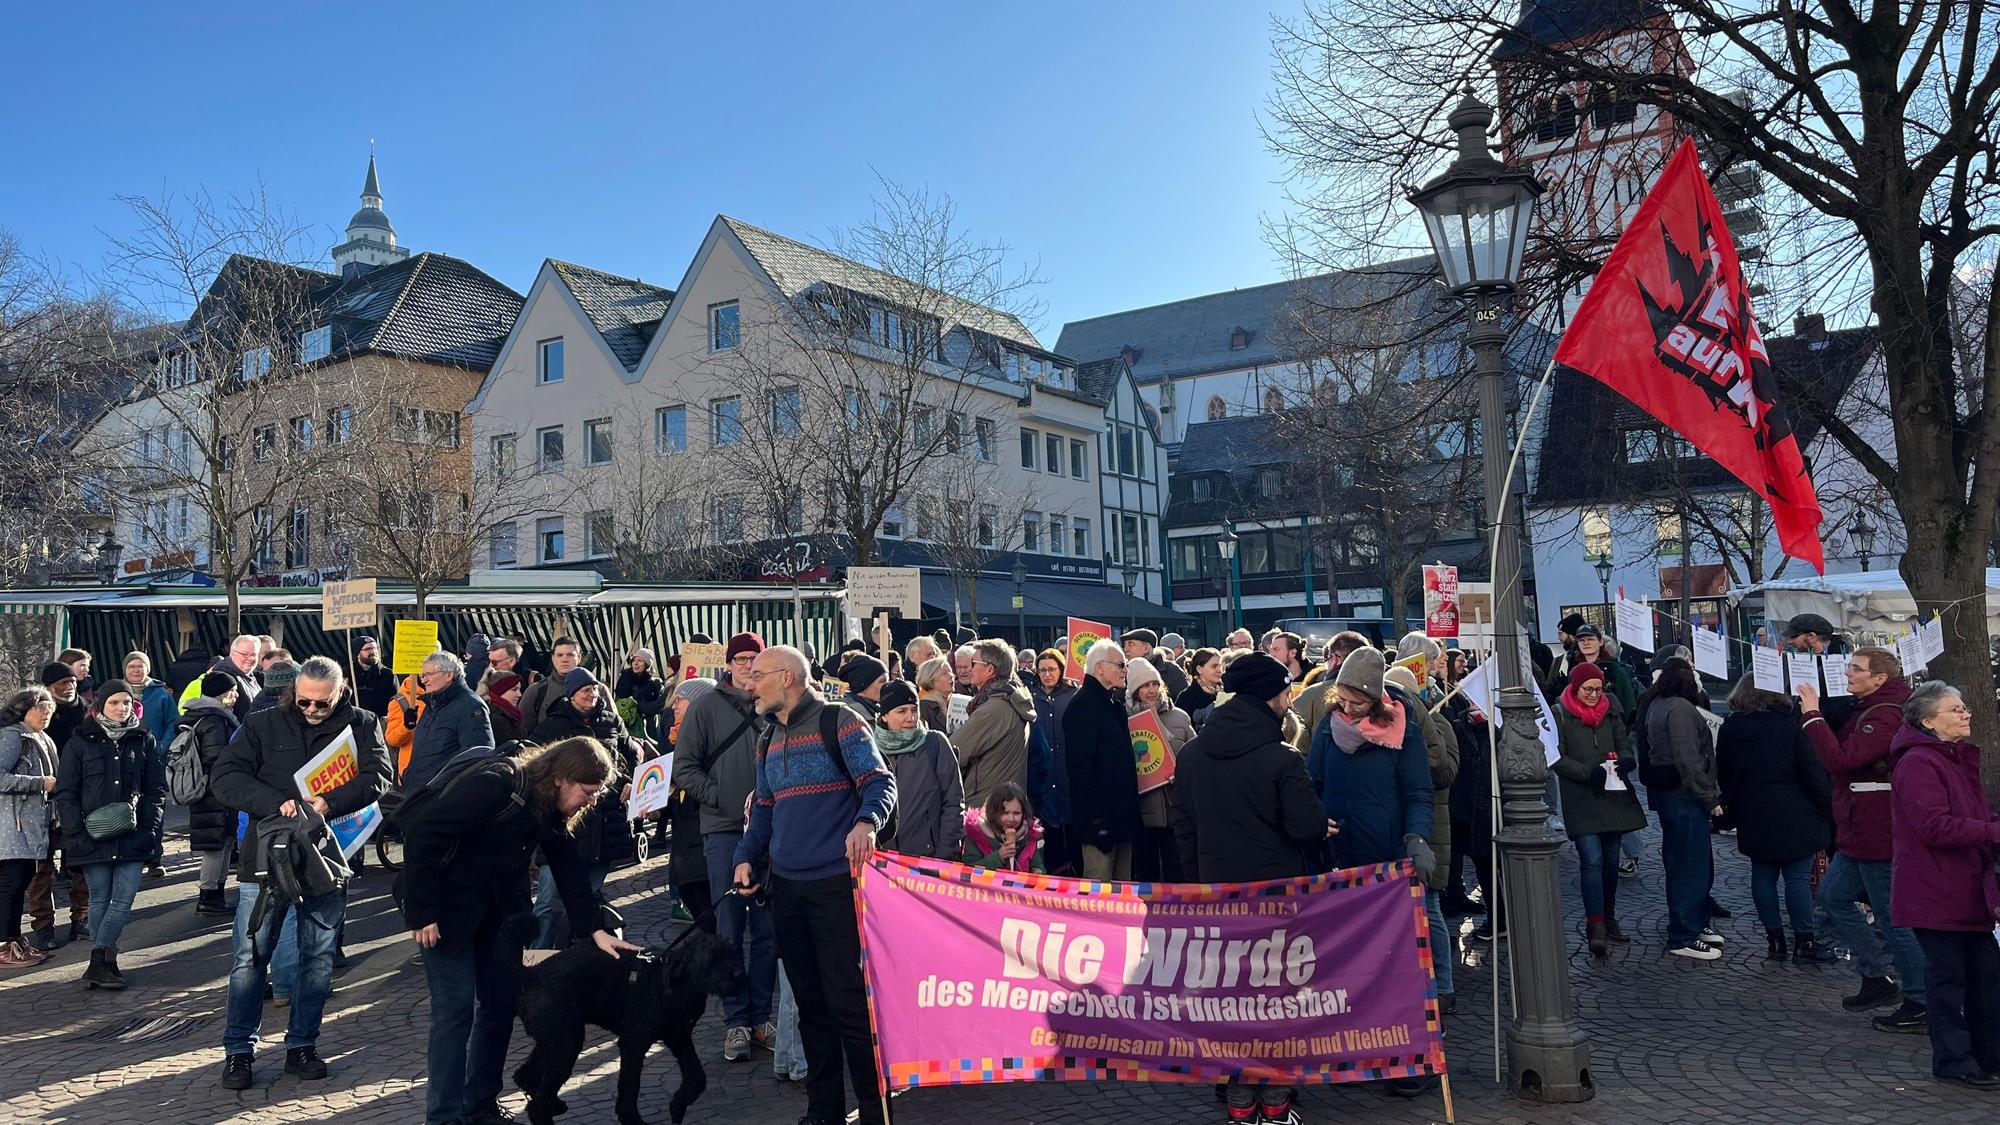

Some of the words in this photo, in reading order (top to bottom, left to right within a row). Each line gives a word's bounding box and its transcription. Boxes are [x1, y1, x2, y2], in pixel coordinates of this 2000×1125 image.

[1437, 571, 1456, 582] Herz
[326, 584, 347, 597] NIE
[1438, 582, 1456, 592] statt
[332, 592, 373, 606] WIEDER
[327, 606, 343, 615] IST
[1439, 611, 1456, 619] RHEIN
[332, 611, 374, 626] JETZT
[684, 644, 727, 656] SIEGBU
[310, 753, 350, 793] DEMO-
[888, 875, 989, 902] GRUNDGESETZ
[994, 893, 1021, 905] DER
[1152, 902, 1254, 915] DEUTSCHLAND,
[1258, 901, 1288, 915] ART.
[1290, 901, 1298, 914] 1
[1000, 917, 1105, 986] Die
[1122, 926, 1317, 989] Würde
[917, 975, 974, 1008] des
[981, 979, 1136, 1020] Menschen
[1142, 991, 1181, 1021] ist
[1185, 987, 1352, 1022] unantastbar.
[1168, 1037, 1195, 1058] für
[1197, 1037, 1308, 1059] Demokratie
[1311, 1032, 1343, 1056] und
[1344, 1024, 1411, 1052] Vielfalt!
